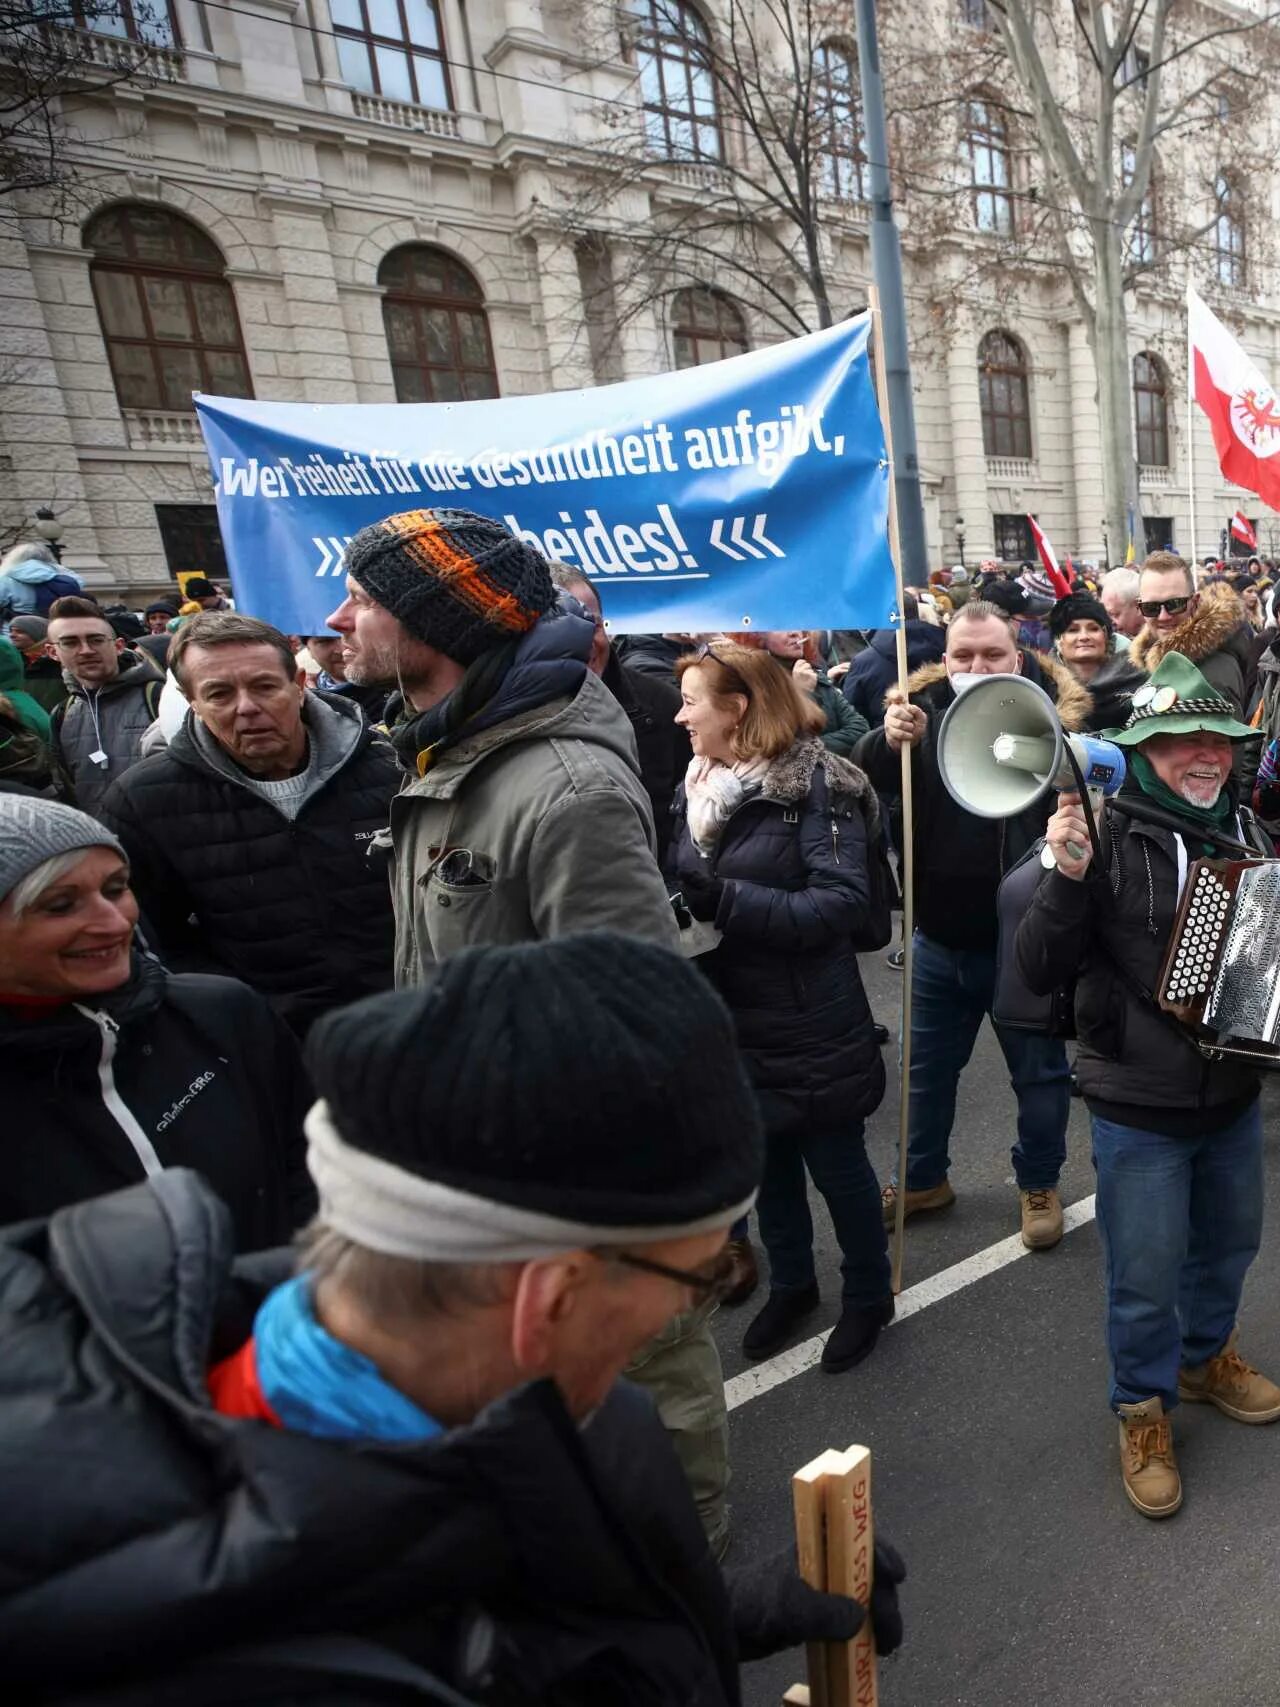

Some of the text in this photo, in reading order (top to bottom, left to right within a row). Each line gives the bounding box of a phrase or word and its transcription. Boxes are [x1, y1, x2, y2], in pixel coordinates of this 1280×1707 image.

[220, 404, 845, 498] Wer Freiheit für die Gesundheit aufgibt,
[852, 1480, 868, 1542] WEG
[854, 1544, 869, 1606] USS
